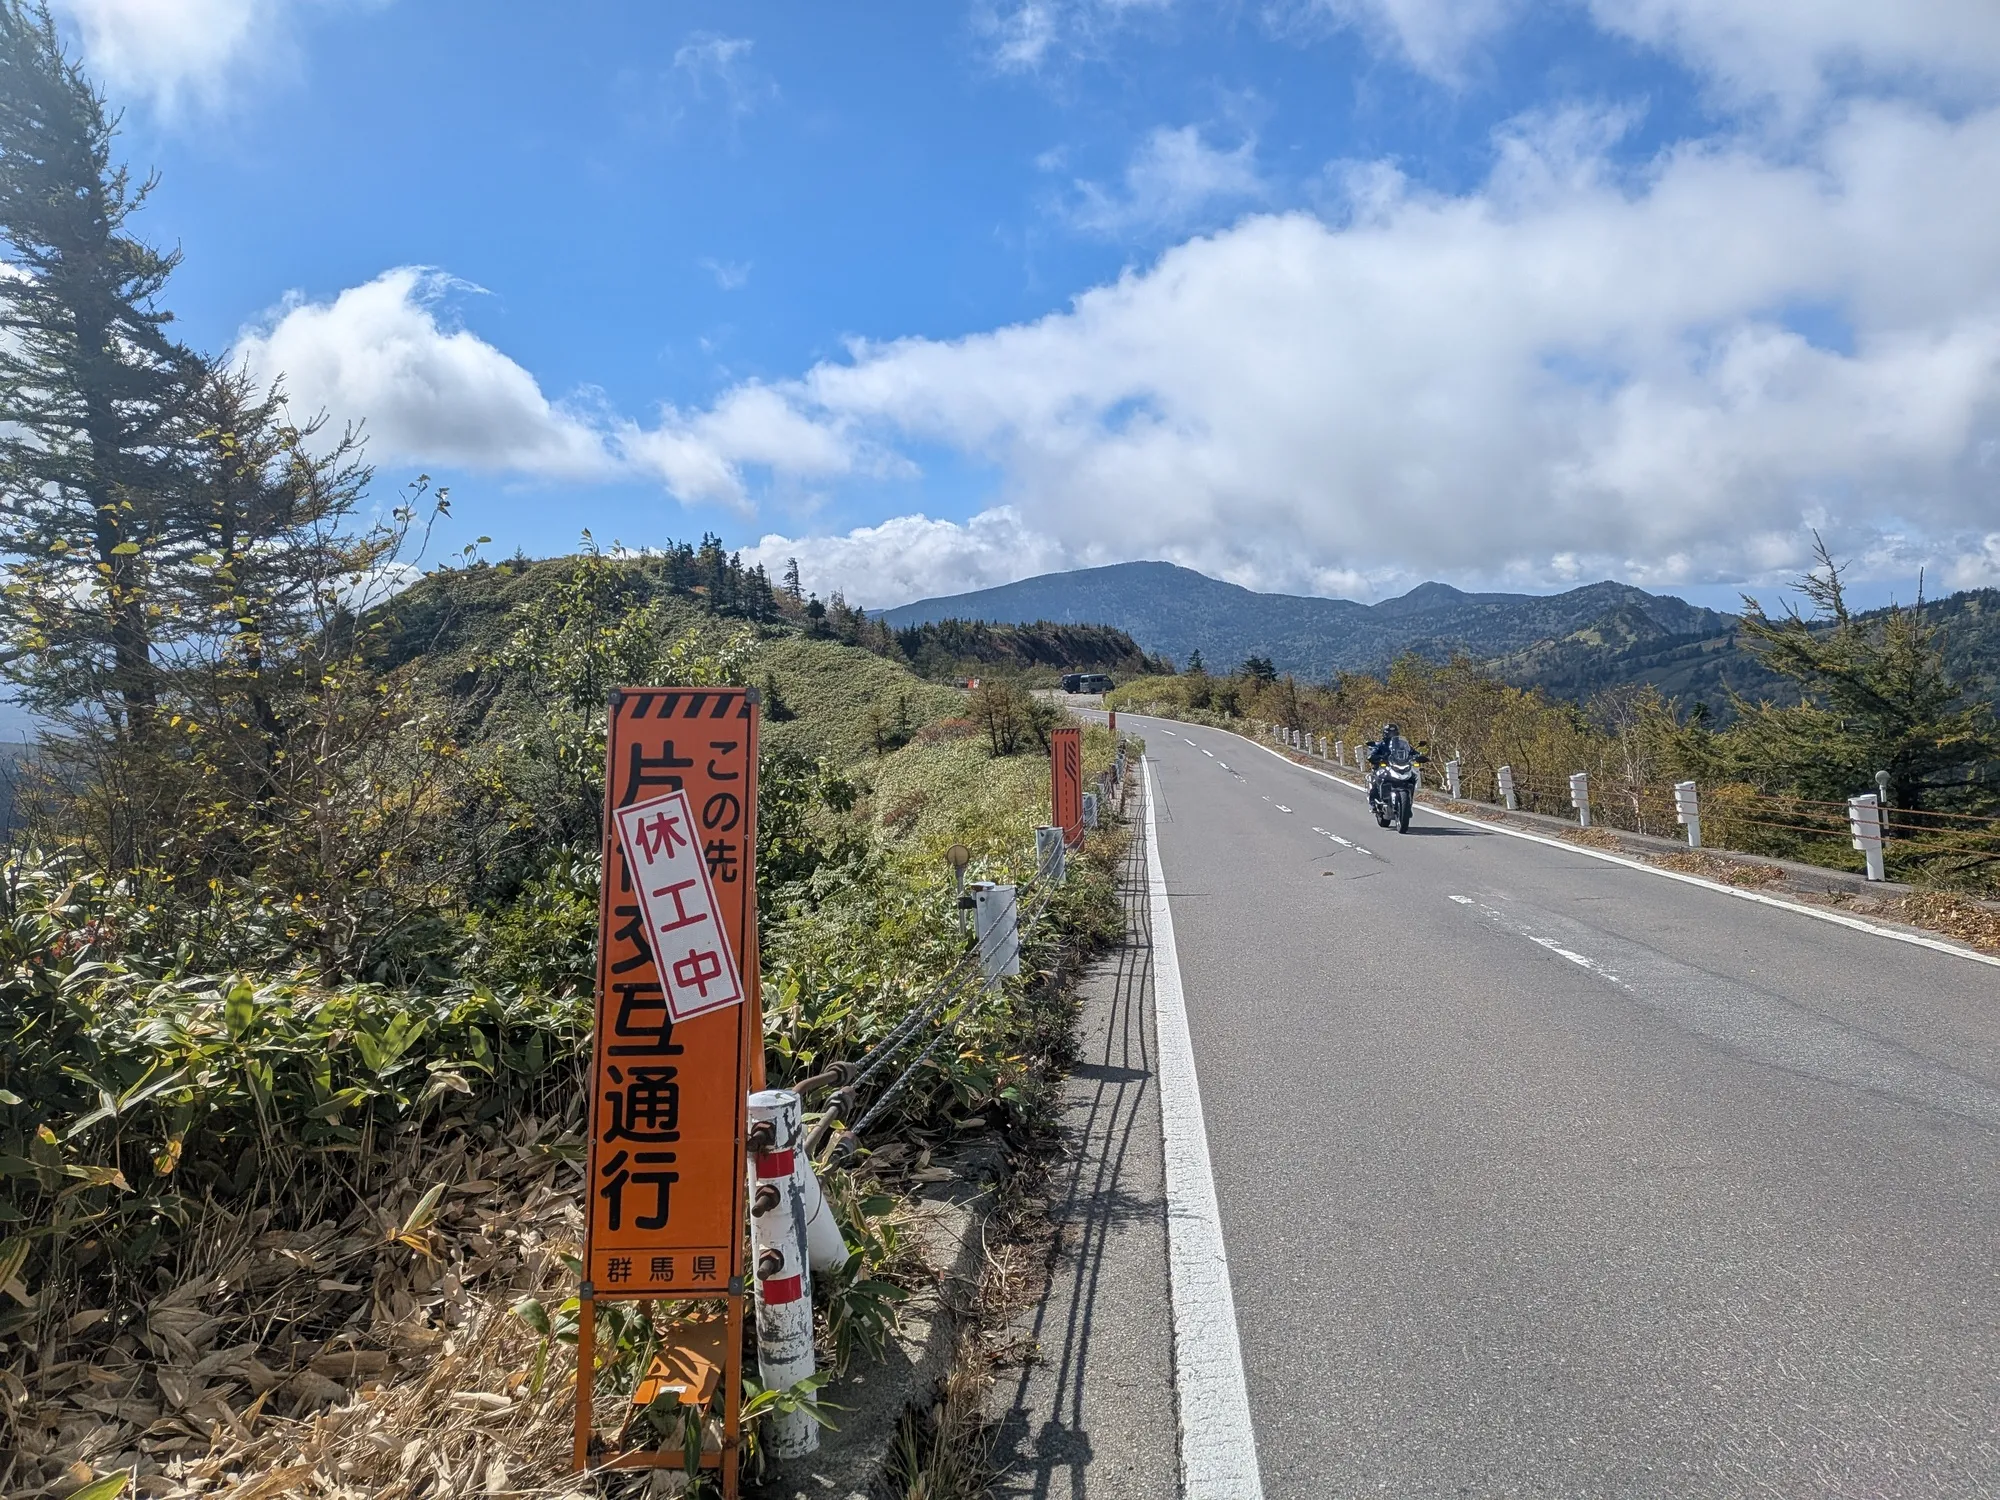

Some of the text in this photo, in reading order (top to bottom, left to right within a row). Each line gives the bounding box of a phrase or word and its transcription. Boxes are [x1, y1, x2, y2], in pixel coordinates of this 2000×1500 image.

[702, 741, 740, 883] この先
[600, 740, 694, 1231] 片交互通行
[635, 812, 722, 998] 休工中
[607, 1256, 717, 1282] 群馬県
